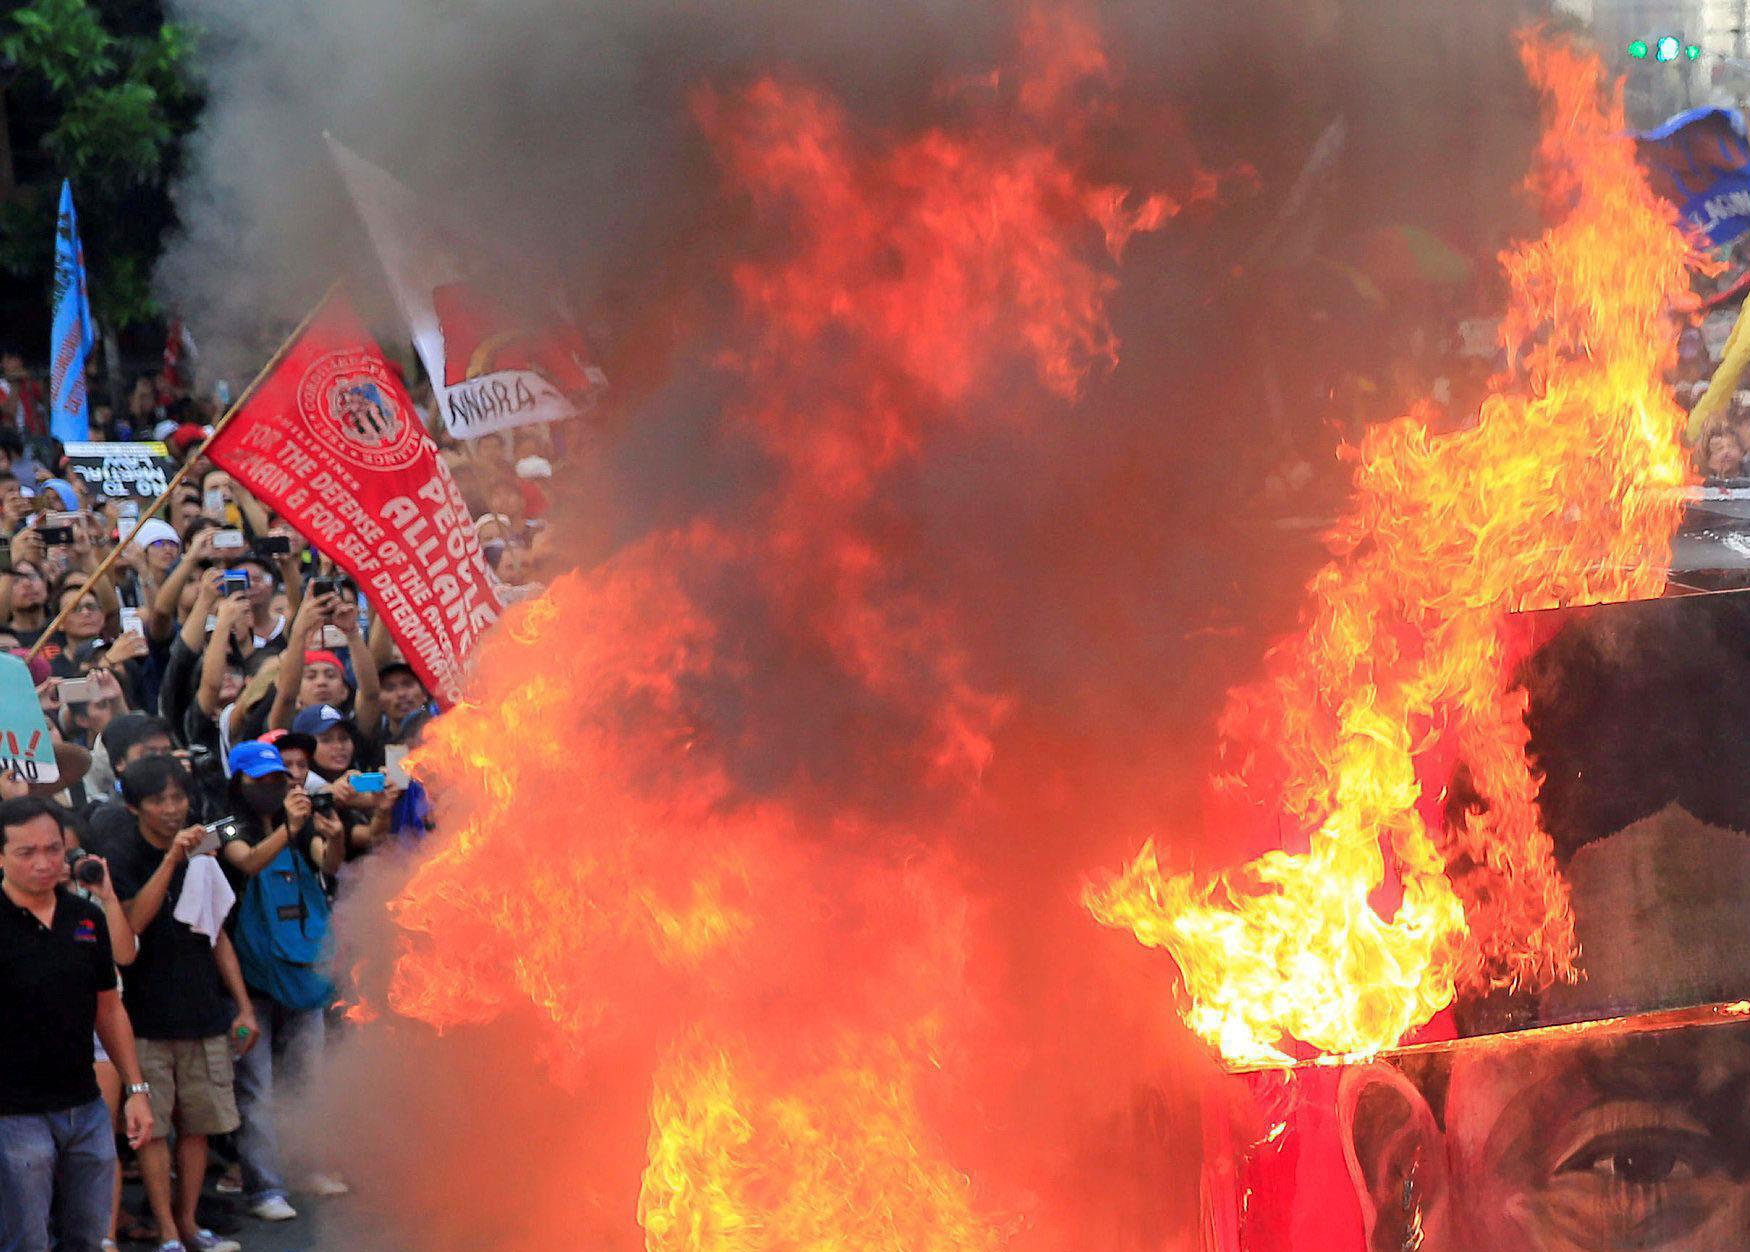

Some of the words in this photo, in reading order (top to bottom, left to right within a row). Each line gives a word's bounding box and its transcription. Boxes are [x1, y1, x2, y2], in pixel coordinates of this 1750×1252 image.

[241, 421, 283, 451] FOR
[276, 441, 319, 479] THE
[308, 470, 384, 547] DEFENSE
[377, 539, 407, 567] OF
[399, 562, 432, 602] THE
[284, 486, 309, 511] &
[299, 500, 347, 543] FOR
[335, 528, 381, 574] SELF
[371, 572, 463, 705] DETERMINATIO
